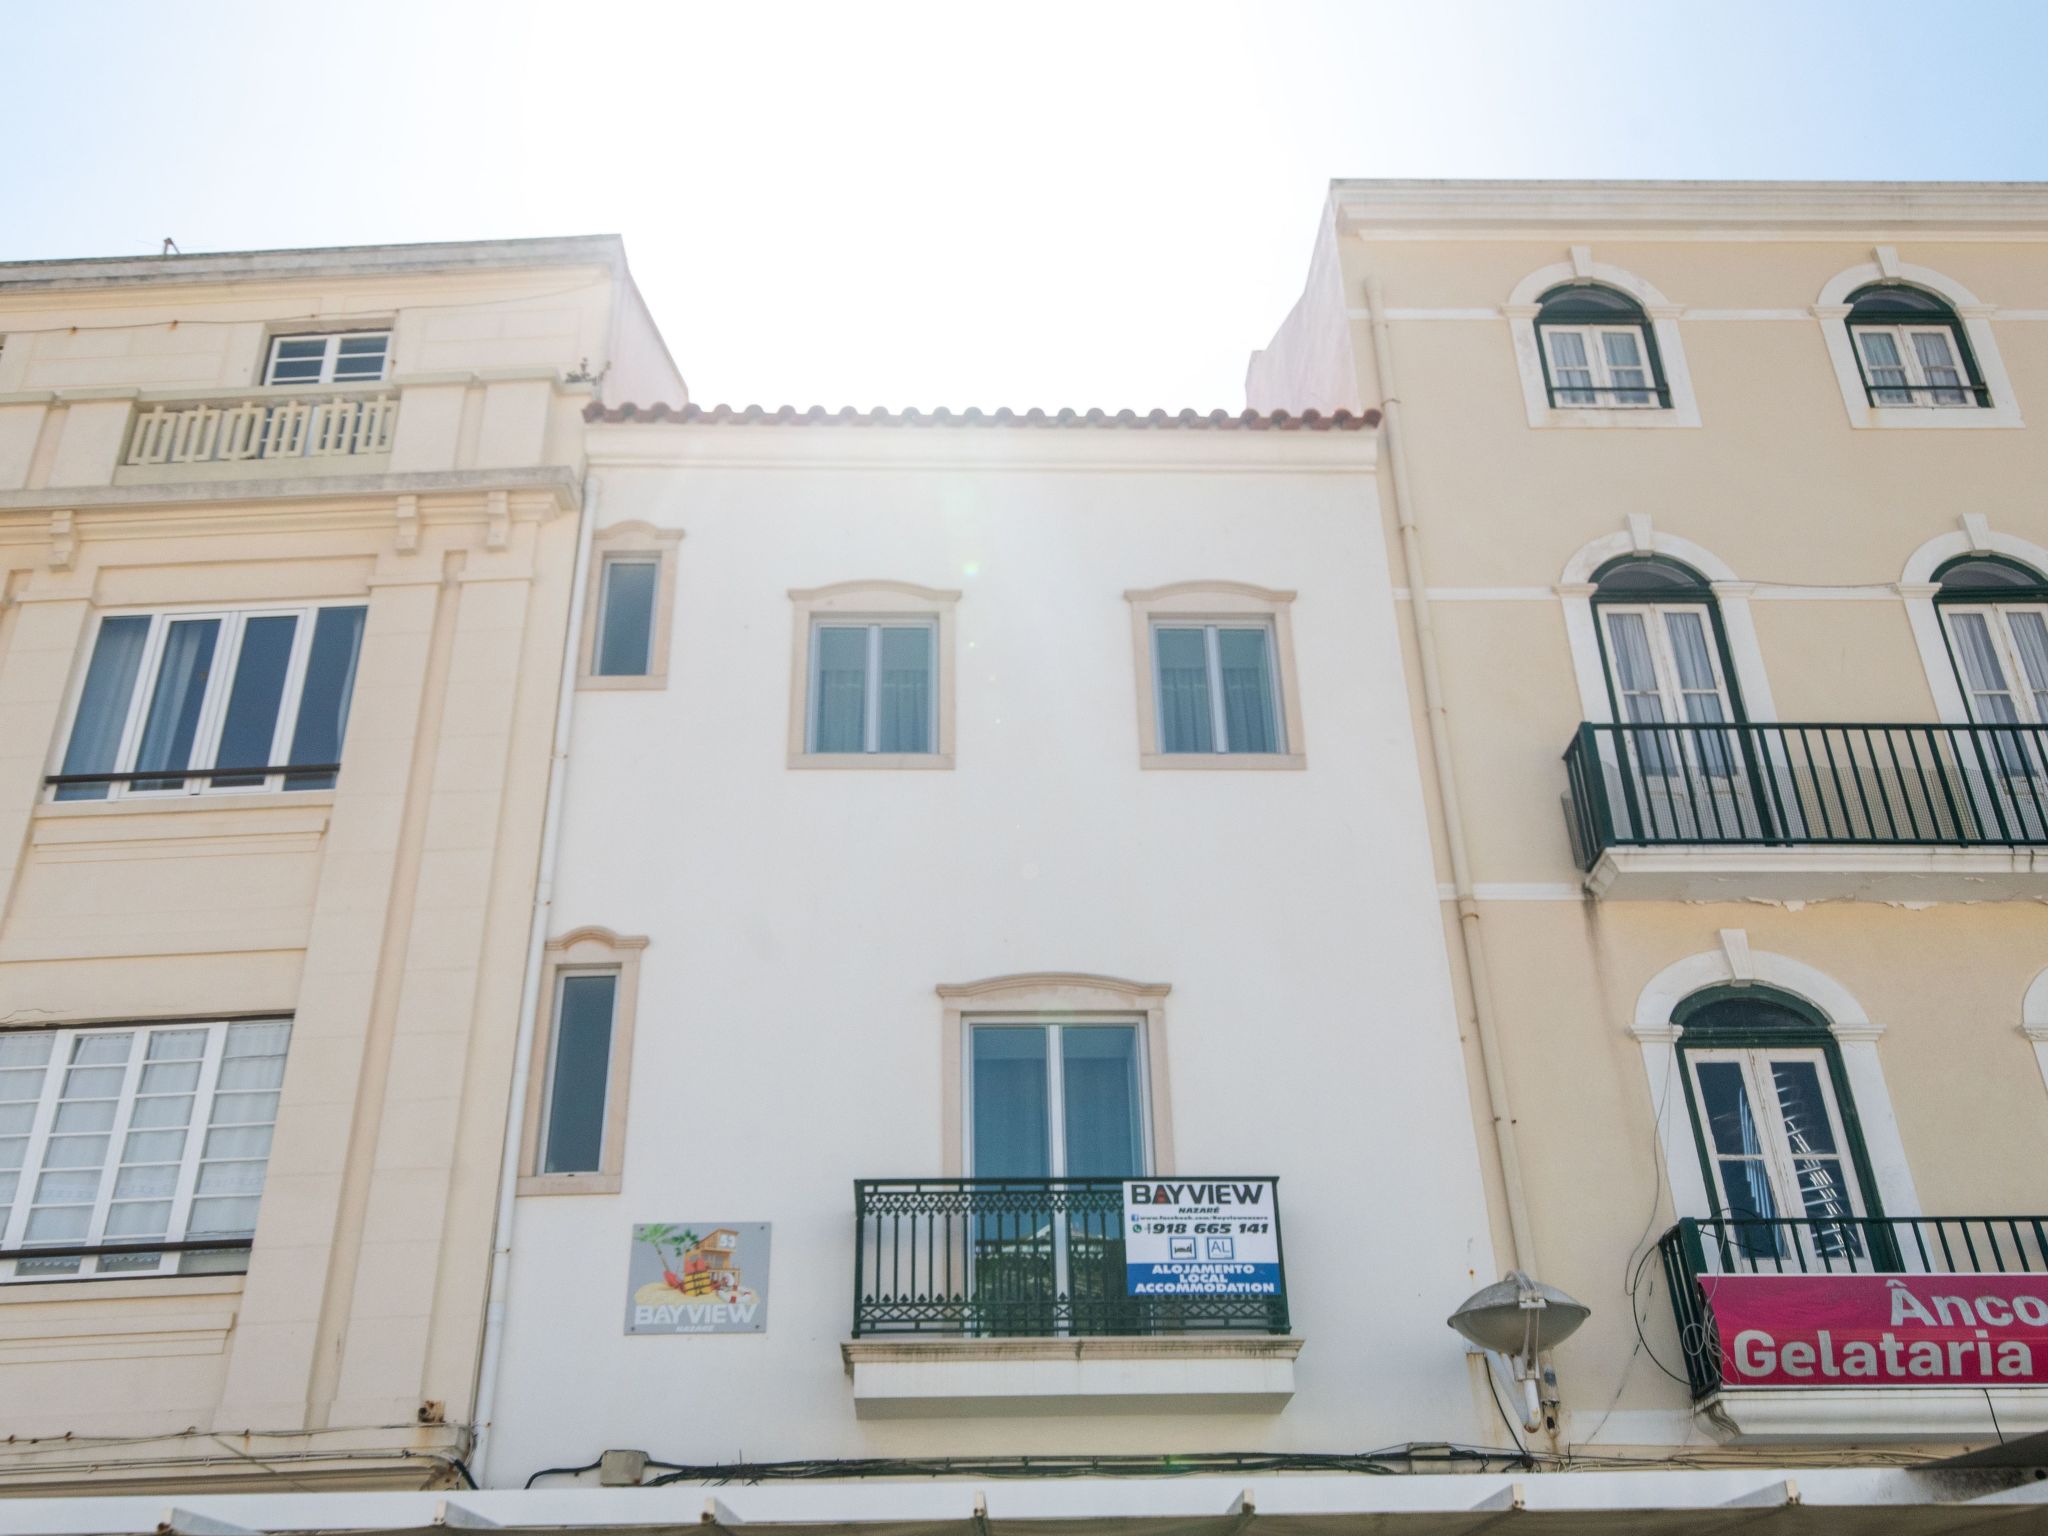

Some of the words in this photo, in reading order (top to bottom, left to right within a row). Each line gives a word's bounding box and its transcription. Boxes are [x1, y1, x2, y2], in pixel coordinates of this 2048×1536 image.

[1131, 1184, 1263, 1205] BAYVIEW
[1178, 1206, 1220, 1214] NAZARÉ
[1152, 1223, 1187, 1234] 918
[1194, 1223, 1232, 1234] 665
[1239, 1223, 1268, 1234] 141
[1211, 1241, 1230, 1253] AL
[1152, 1264, 1255, 1274] ALOJAMENTO
[1179, 1274, 1228, 1283] LOCAL
[1135, 1283, 1275, 1293] ACCOMMODATION
[634, 1303, 758, 1325] BAYVIEW
[1733, 1329, 2034, 1377] Gelataria
